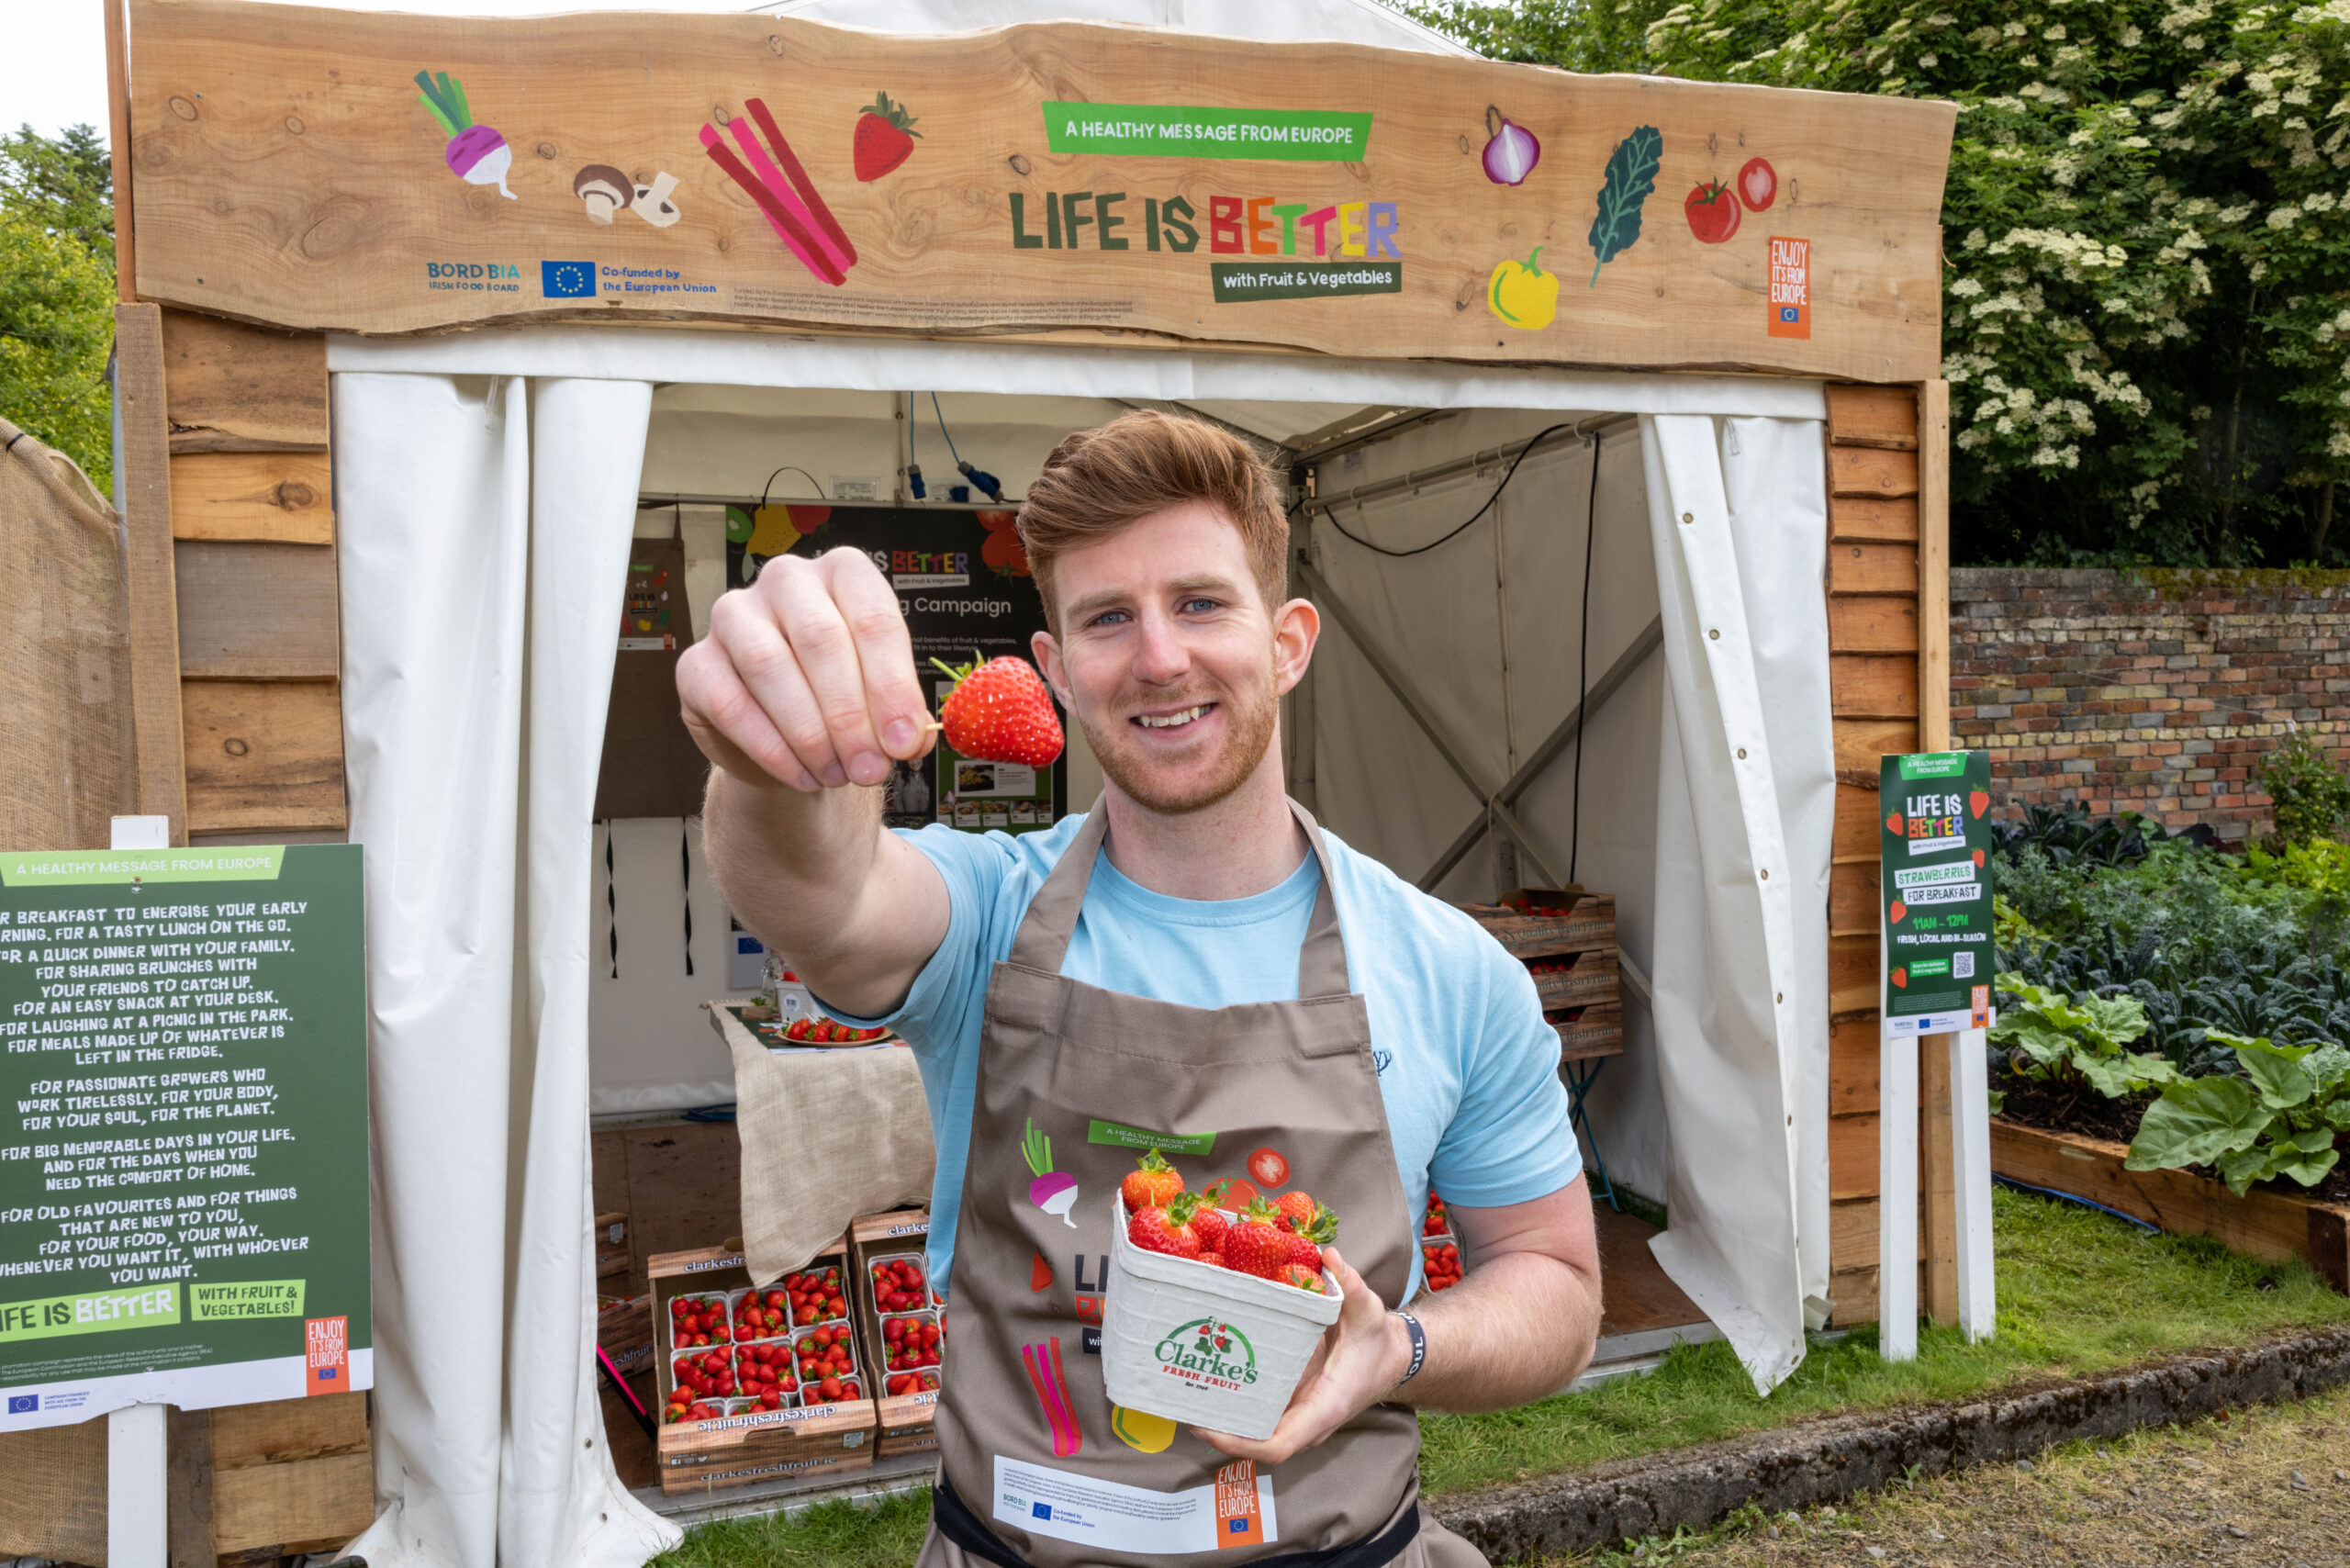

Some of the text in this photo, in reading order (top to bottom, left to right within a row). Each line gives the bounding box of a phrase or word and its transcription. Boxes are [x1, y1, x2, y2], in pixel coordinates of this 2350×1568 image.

[1065, 120, 1351, 143] A HEALTHY MESSAGE FROM EUROPE
[1009, 192, 1403, 257] LIFE IS BETTER
[1773, 240, 1807, 266] ENJOY
[428, 263, 520, 279] BORD BIA
[602, 267, 679, 280] Co-funded by
[1223, 270, 1392, 287] with Fruit & Vegetables
[1773, 266, 1805, 285] IT'S FROM
[487, 284, 520, 292] BOARD
[603, 282, 716, 294] the European Union
[1772, 284, 1807, 305] EUROPE
[892, 551, 968, 573] BETTER
[914, 598, 1011, 618] Campaign
[1908, 793, 1962, 817] LIFE IS
[1908, 816, 1964, 837] BETTER
[17, 857, 271, 874] A HEALTHY MESSAGE FROM EUROPE
[1898, 866, 1971, 885] STRAWBERRIES
[1908, 887, 1976, 902] FOR BREAKFAST
[1517, 921, 1608, 940] Quality Irish Fruit
[1913, 917, 1937, 930] 11AM
[1946, 914, 1968, 927] 12PM
[1897, 933, 1986, 946] FRESH, LOCAL AND IN-SEASON
[36, 958, 256, 979] FOR SHARING BRUNCHES WITH
[41, 976, 252, 997] YOUR FRIENDS TO CATCH UP.
[1561, 976, 1583, 987] Irish
[1587, 974, 1611, 984] Fruit
[1567, 1027, 1615, 1039] Irish Fruit
[1115, 1129, 1155, 1141] HEALTHY
[1122, 1137, 1185, 1149] FROM EUROPE
[46, 1163, 254, 1190] NEED THE COMFORT OF HOME.
[59, 1208, 243, 1235] THAT ARE NEW TO YOU,
[1075, 1254, 1108, 1293] LI
[199, 1285, 297, 1300] WITH FRUIT &
[0, 1289, 173, 1331] IFE IS BETTER
[201, 1301, 295, 1316] VEGETABLES!
[308, 1319, 344, 1340] ENJOY
[310, 1338, 343, 1352] IT'S FROM
[310, 1350, 344, 1368] EUROPE
[1155, 1339, 1258, 1384] Clarke's
[1400, 1337, 1423, 1382] OUL
[1162, 1365, 1241, 1391] FRESH FRUIT
[699, 1406, 836, 1432] clarkesfreshfruit.ie
[700, 1457, 836, 1482] clarkesfreshfruit.ie
[1218, 1459, 1252, 1484] ENJOY
[1219, 1480, 1253, 1498] IT'S FROM
[1003, 1494, 1017, 1504] BORD
[1219, 1495, 1256, 1518] EUROPE
[1054, 1508, 1076, 1518] Co-funded
[1060, 1517, 1080, 1525] European
